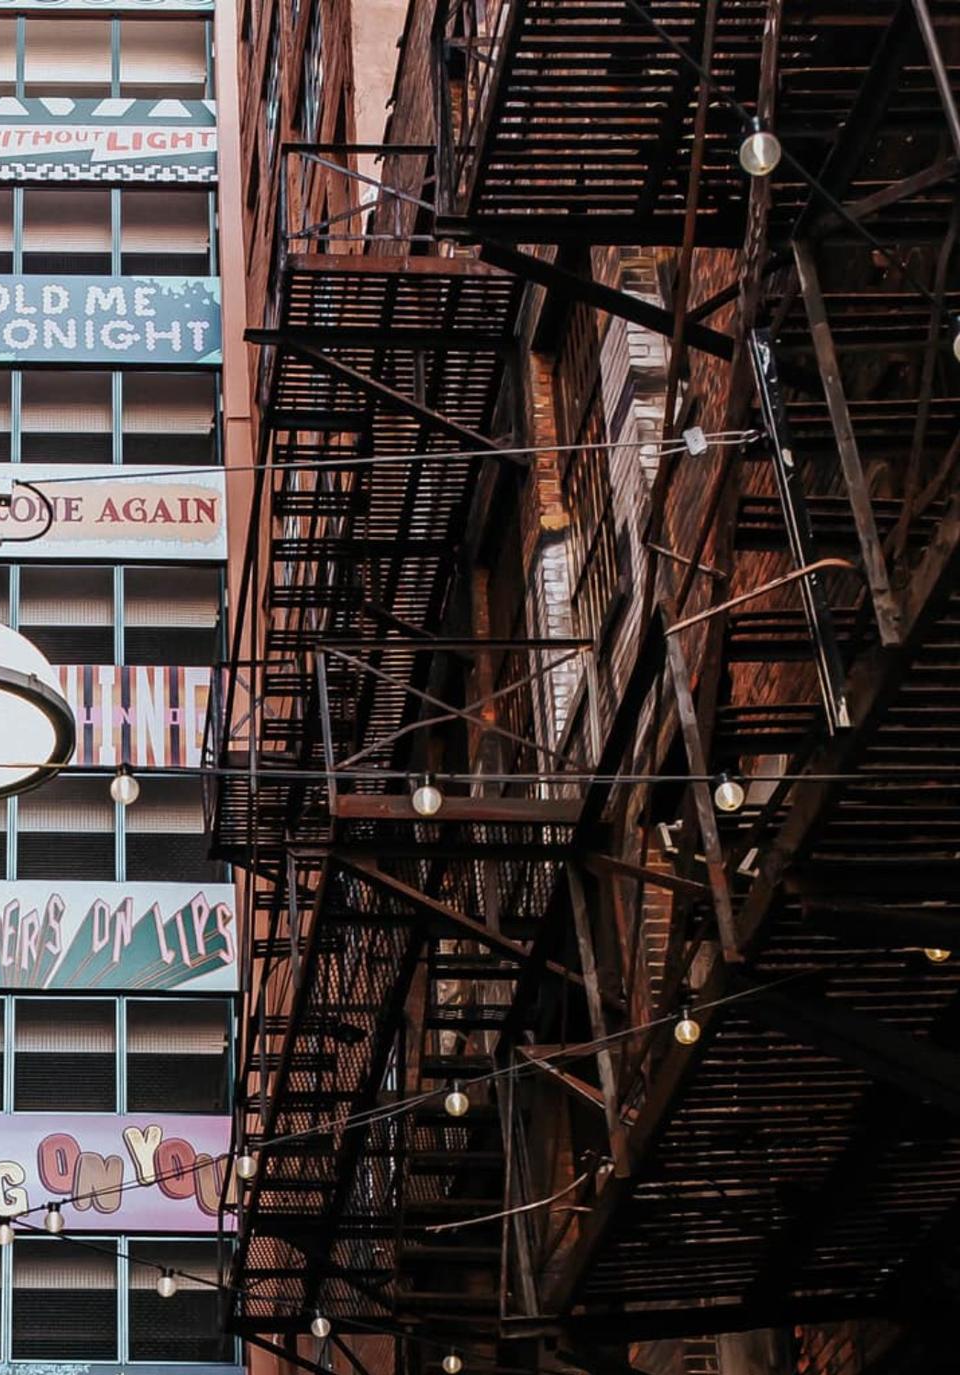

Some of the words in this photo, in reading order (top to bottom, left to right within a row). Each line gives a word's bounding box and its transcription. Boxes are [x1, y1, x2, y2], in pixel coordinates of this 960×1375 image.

[105, 131, 216, 152] LIGHT
[84, 285, 157, 318] ME
[94, 497, 218, 524] AGAIN
[92, 897, 134, 964] ON
[149, 891, 235, 968] LIPS
[37, 1133, 124, 1215] ON
